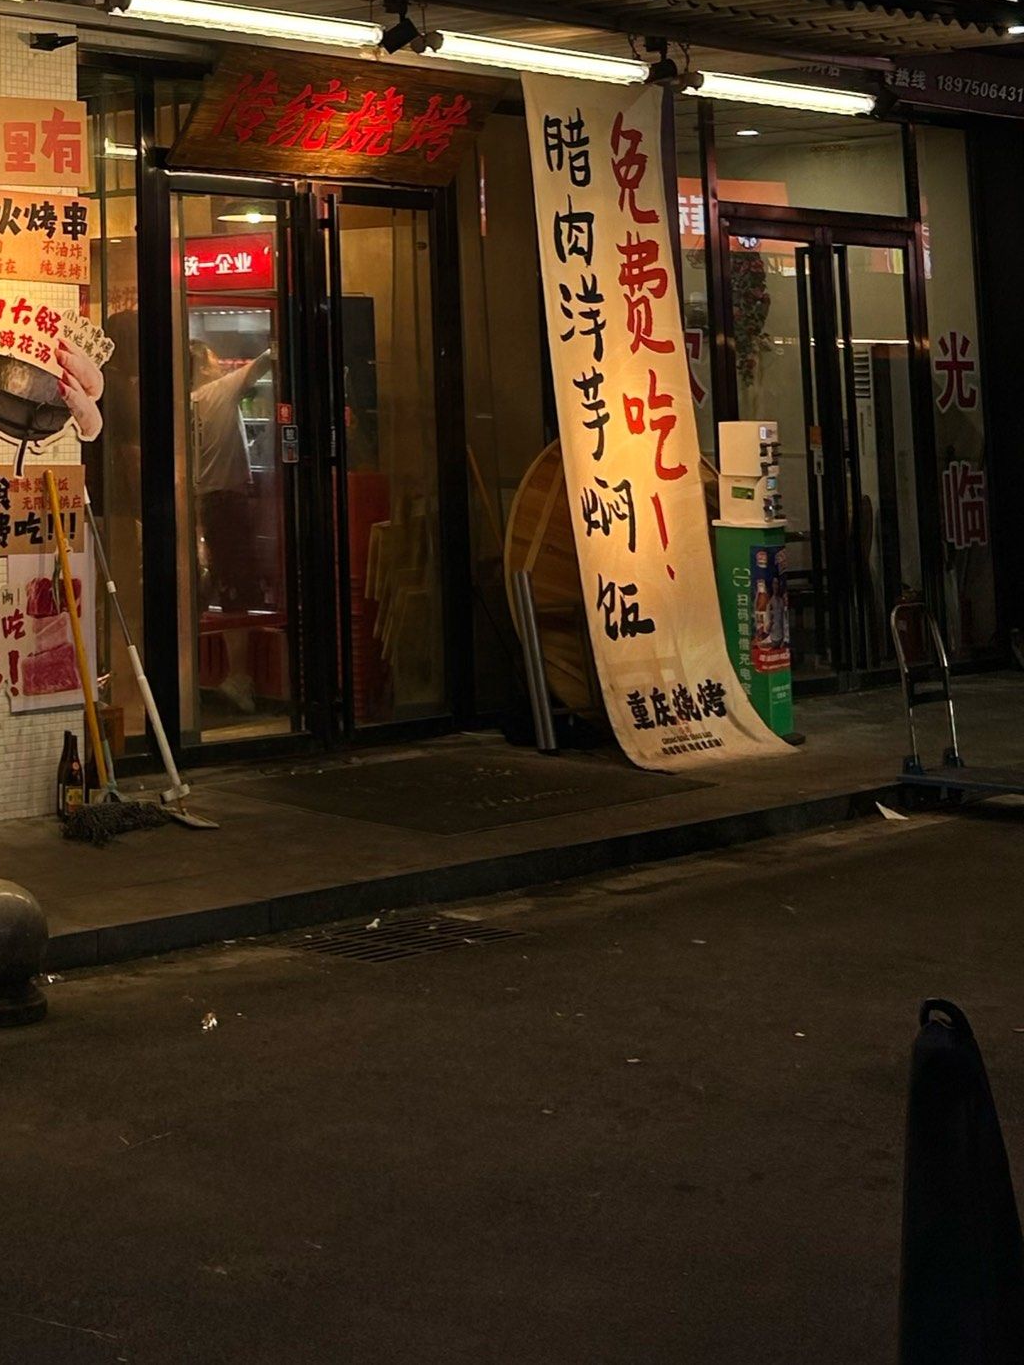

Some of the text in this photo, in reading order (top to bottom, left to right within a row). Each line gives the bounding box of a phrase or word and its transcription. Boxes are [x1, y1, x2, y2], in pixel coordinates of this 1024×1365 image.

[184, 252, 253, 276] 统一企业
[543, 107, 656, 641] 腊肉洋芋焖饭
[935, 331, 988, 549] 光临
